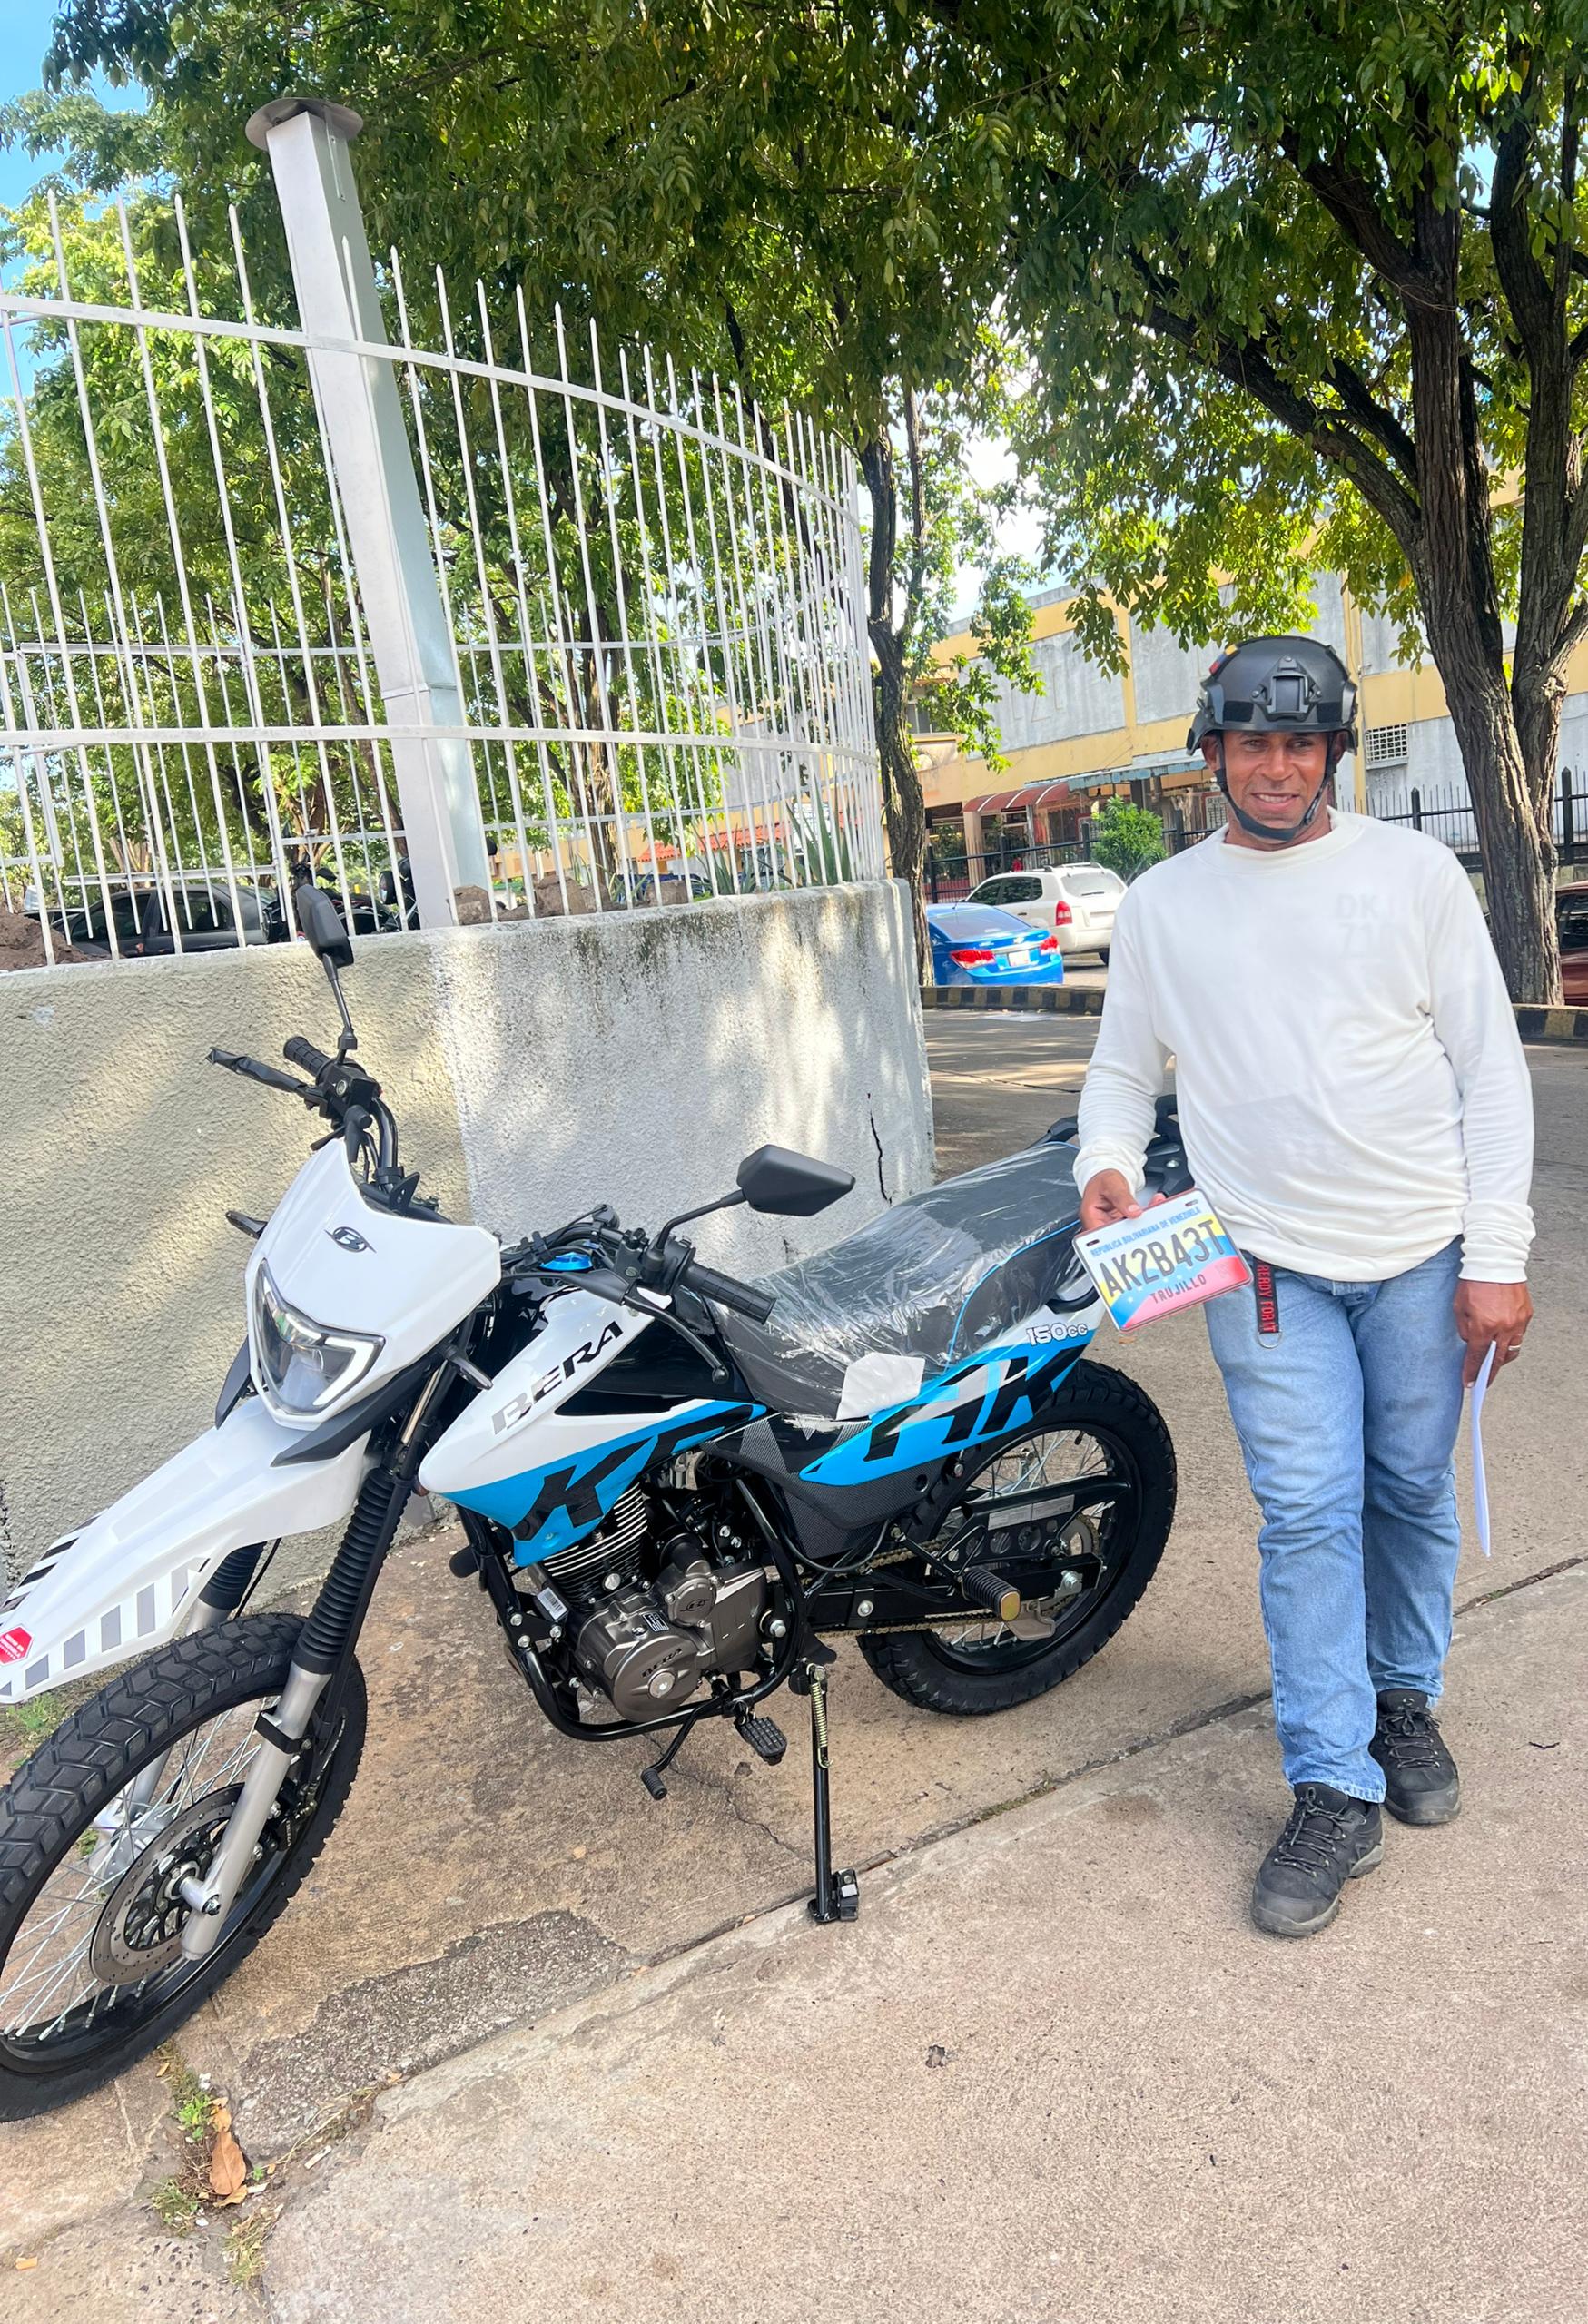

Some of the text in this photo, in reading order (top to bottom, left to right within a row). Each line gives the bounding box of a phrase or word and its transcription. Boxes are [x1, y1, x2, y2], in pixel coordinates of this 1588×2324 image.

[1099, 1219, 1225, 1298] AK2B43T
[1150, 1274, 1207, 1304] TRUJILLO
[1260, 1301, 1275, 1321] FOR
[1026, 1322, 1089, 1347] 150cc
[491, 1320, 624, 1435] BERA
